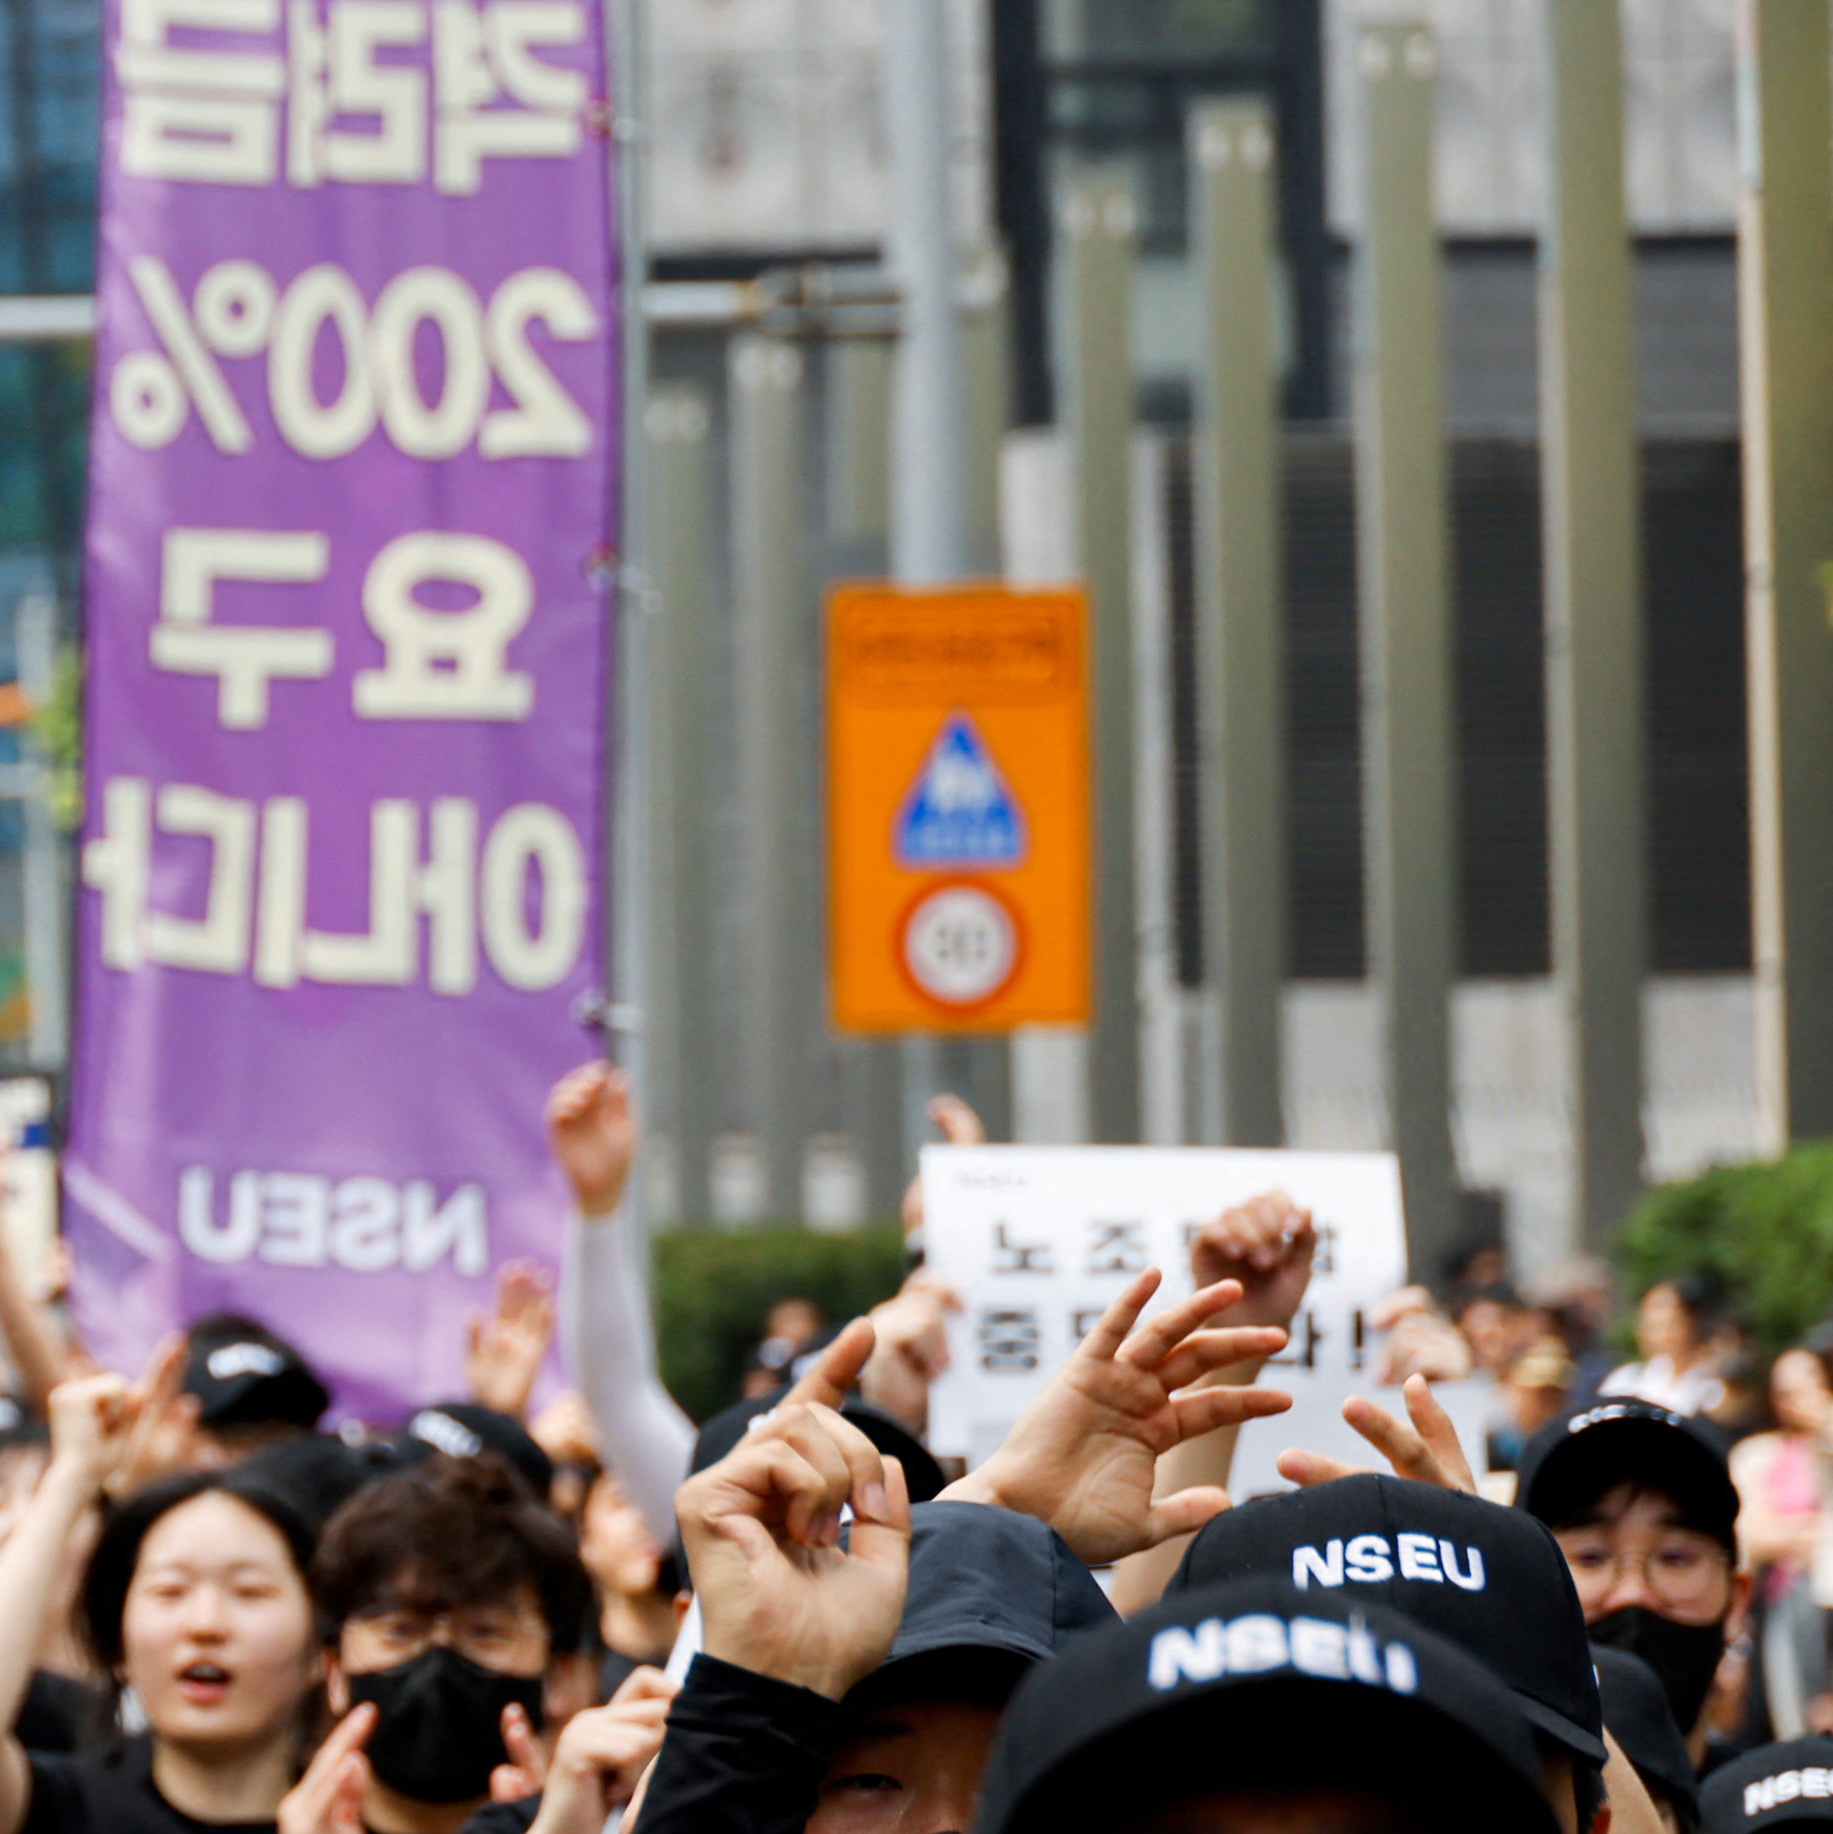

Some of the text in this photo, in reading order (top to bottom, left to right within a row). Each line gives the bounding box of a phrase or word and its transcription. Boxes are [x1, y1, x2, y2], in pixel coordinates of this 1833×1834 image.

[1290, 1532, 1486, 1592] NSEU
[1146, 1611, 1419, 1697] NSEU
[1744, 1766, 1833, 1816] NSE
